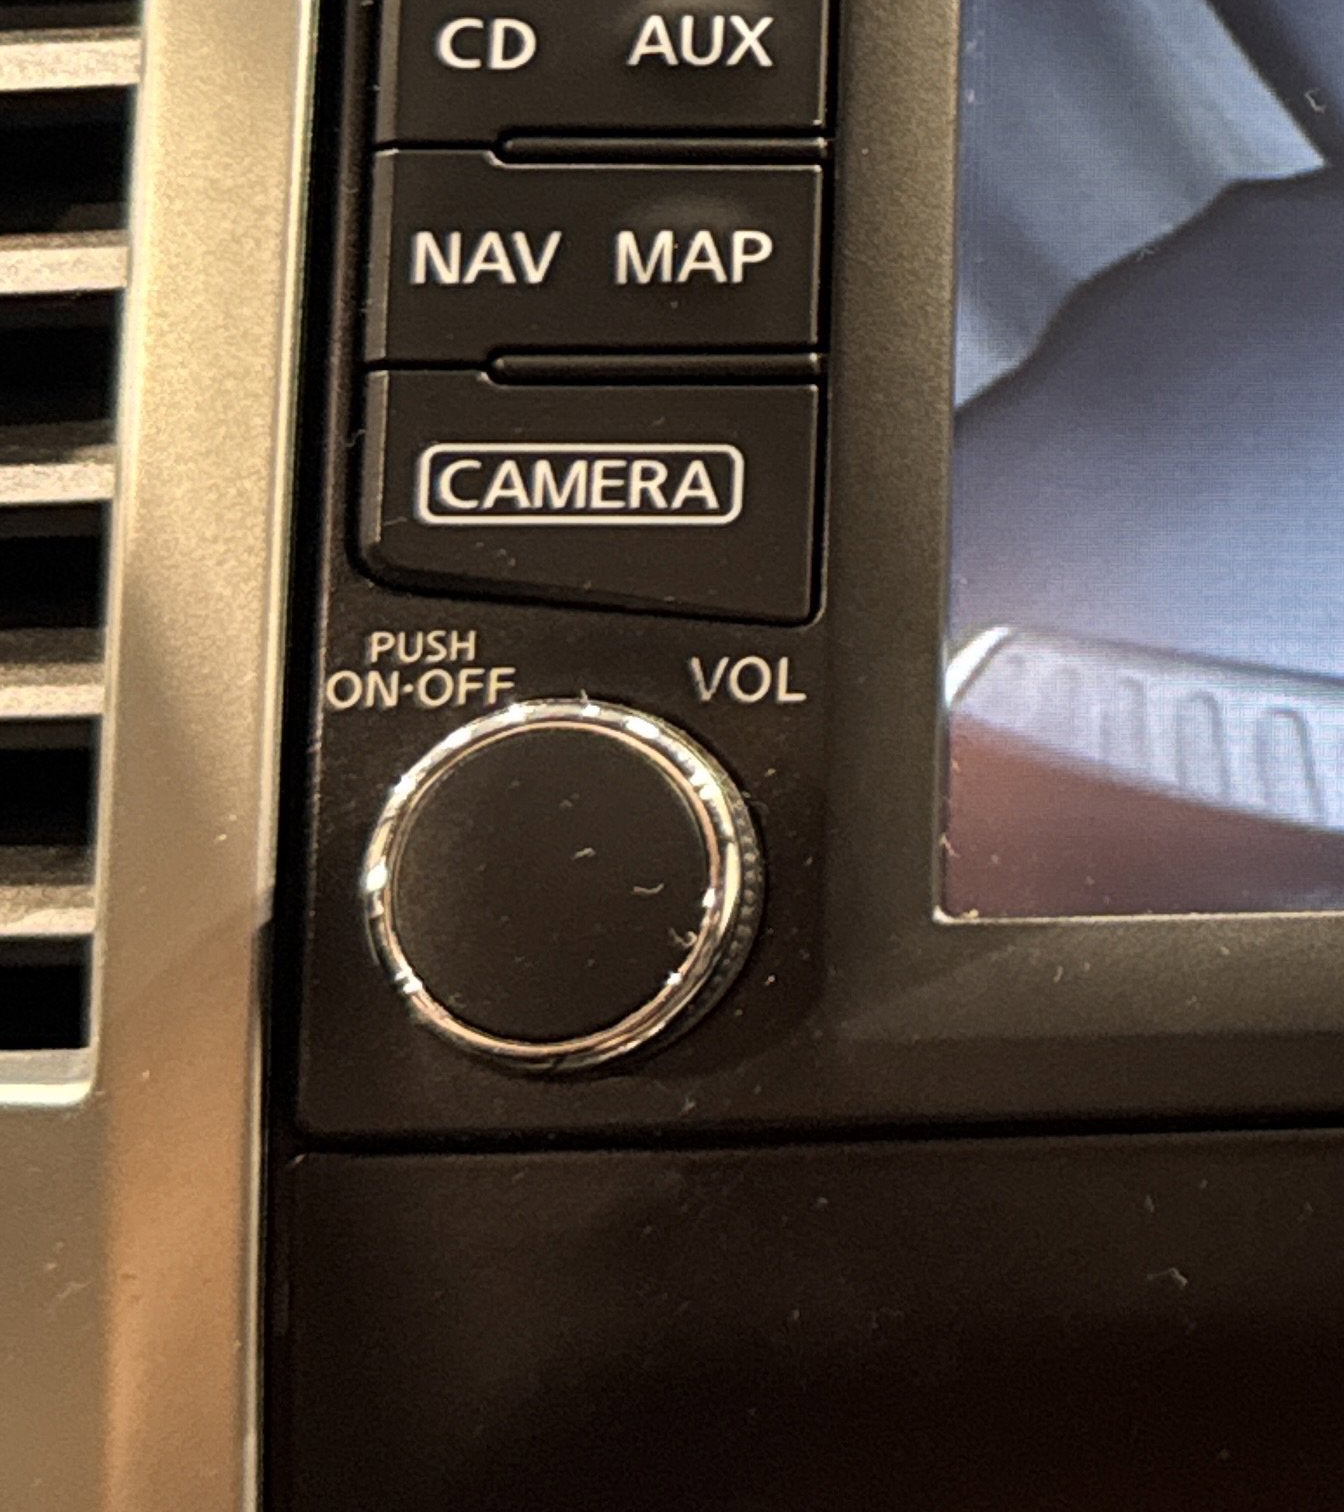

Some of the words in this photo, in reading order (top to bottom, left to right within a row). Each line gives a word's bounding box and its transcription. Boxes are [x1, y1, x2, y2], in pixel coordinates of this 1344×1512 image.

[435, 17, 537, 70] CD
[626, 15, 775, 68] AUX
[410, 230, 562, 285] NAV
[614, 230, 774, 285] MAP
[438, 458, 720, 511] CAMERA
[368, 629, 478, 664] PUSH
[690, 655, 808, 704] VOL
